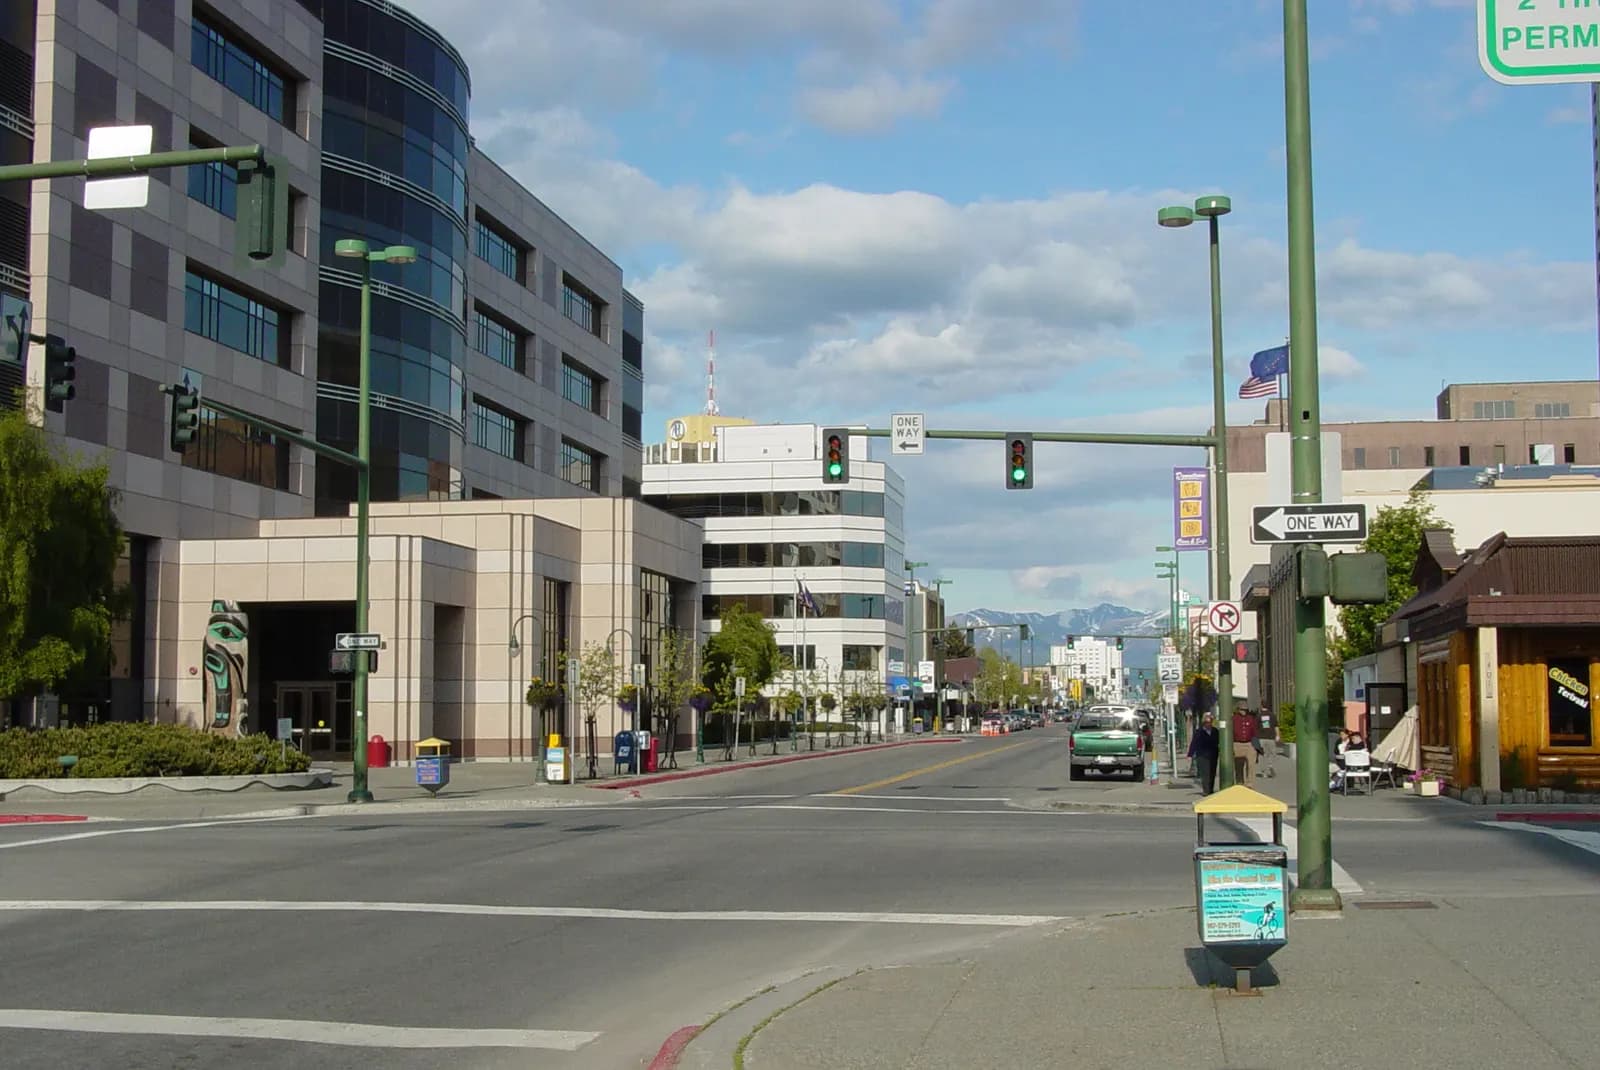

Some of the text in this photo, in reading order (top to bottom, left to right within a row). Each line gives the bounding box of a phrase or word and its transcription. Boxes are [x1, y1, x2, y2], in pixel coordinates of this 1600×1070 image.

[897, 417, 919, 427] ONE
[896, 427, 920, 437] WAY
[1286, 514, 1354, 530] ONE WAY
[1161, 669, 1180, 681] 25
[1550, 668, 1587, 695] Chicken
